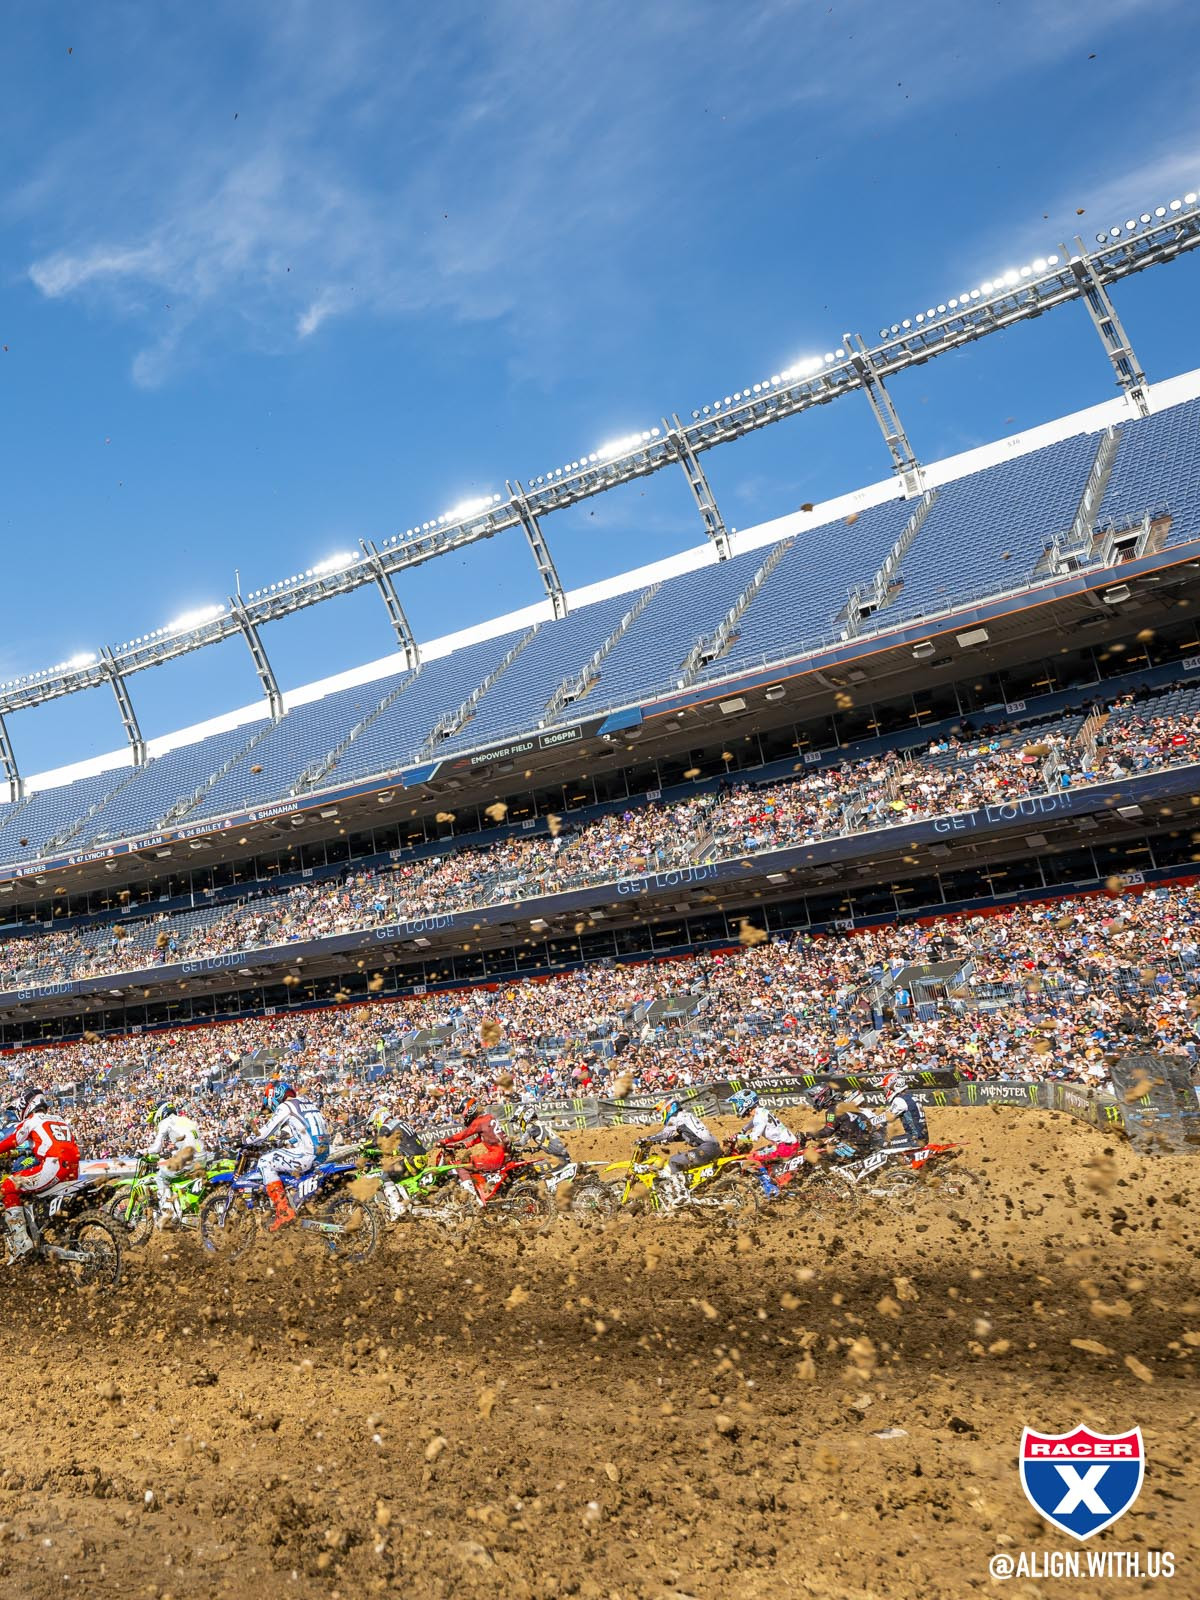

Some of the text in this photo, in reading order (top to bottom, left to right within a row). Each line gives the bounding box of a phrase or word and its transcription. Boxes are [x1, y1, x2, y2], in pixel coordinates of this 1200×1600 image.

[1007, 702, 1025, 713] 339
[544, 731, 576, 744] 5:06PM
[471, 742, 533, 765] EMPOWER FIELD
[805, 754, 821, 763] 338
[258, 803, 298, 819] SHANAHAN
[934, 792, 1073, 833] GET LOUD!!
[186, 823, 222, 837] 24 BAILEY
[143, 837, 162, 847] ELAM
[76, 851, 105, 863] 47 LYNCH
[23, 865, 46, 876] REEVES
[617, 864, 718, 895] GET LOUD!!
[376, 914, 454, 940] GET LOUD!!
[181, 954, 246, 973] GET LOUD!!
[17, 983, 73, 1000] GET LOUD!!
[413, 985, 426, 994] 122
[745, 1077, 801, 1089] MONSTER
[980, 1085, 1027, 1098] MONSTER
[759, 1096, 809, 1107] ONSTER
[298, 1176, 320, 1199] 116
